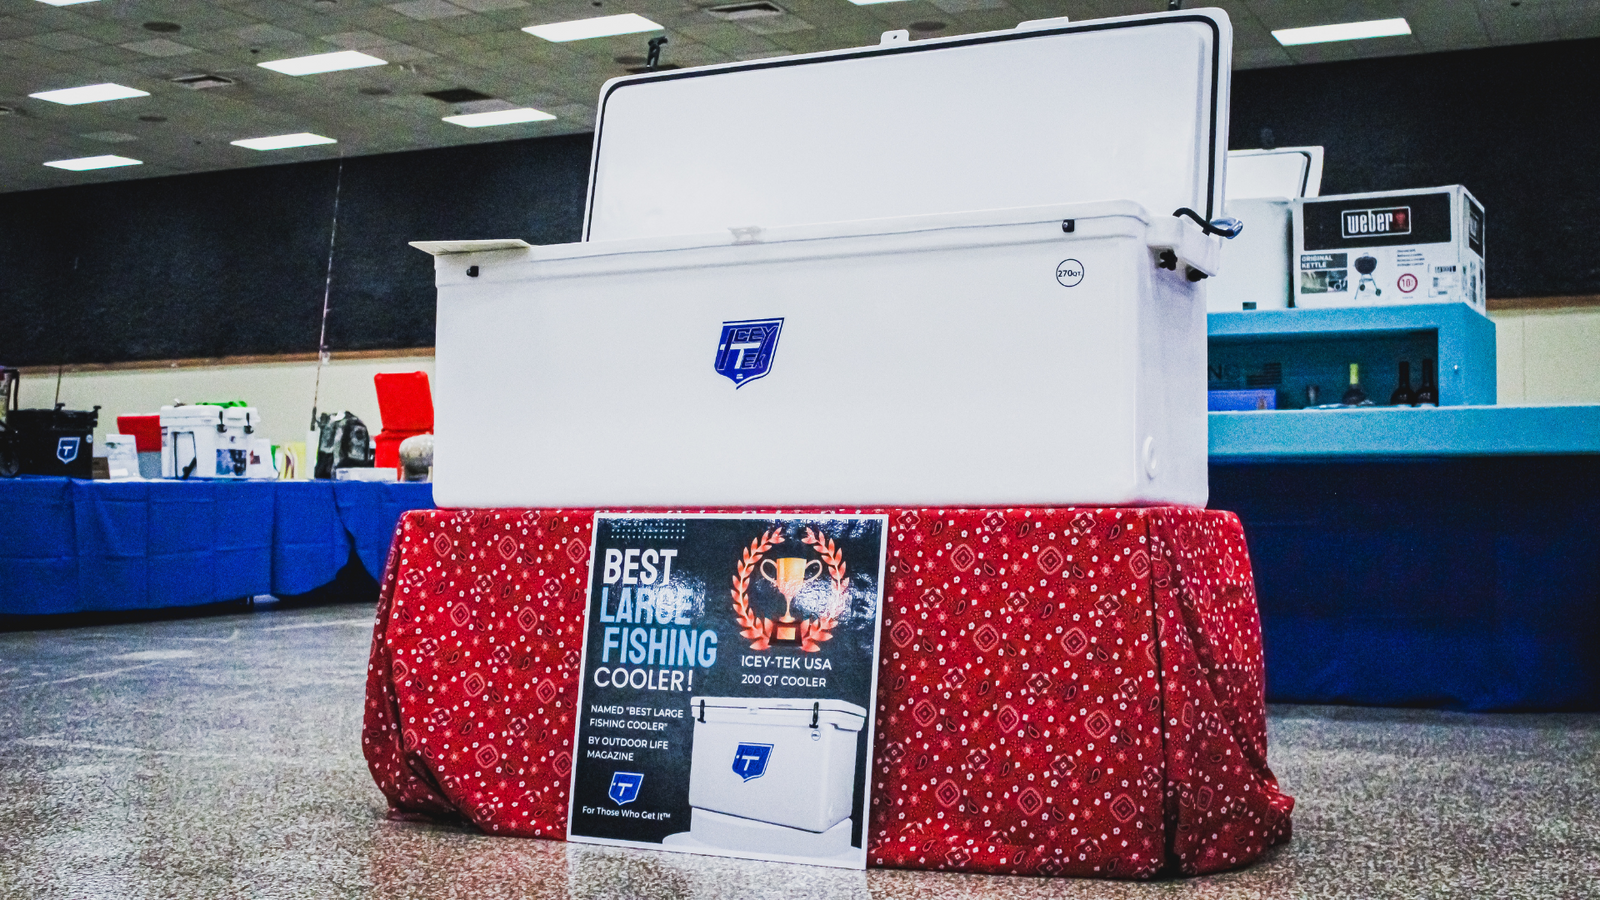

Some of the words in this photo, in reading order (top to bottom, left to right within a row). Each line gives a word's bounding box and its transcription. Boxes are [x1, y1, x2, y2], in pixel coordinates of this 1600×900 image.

[1346, 209, 1393, 234] weber
[1301, 261, 1327, 269] KETTLE
[603, 548, 678, 586] BEST
[600, 586, 694, 626] LARGE
[602, 626, 718, 668] FISHING
[741, 655, 801, 669] ICEY-TEK
[804, 657, 832, 671] USA
[593, 666, 693, 692] COOLER!
[741, 674, 761, 685] 200
[763, 675, 778, 687] QT
[780, 676, 826, 688] COOLER
[590, 705, 624, 715] NAMED
[625, 706, 652, 717] "BEST
[653, 708, 684, 719] LARGE
[589, 718, 625, 729] FISHING
[626, 720, 668, 731] COOLER"
[588, 736, 600, 745] BY
[601, 736, 648, 748] OUTDOOR
[649, 740, 669, 750] LIFE
[586, 749, 634, 762] MAGAZINE
[582, 805, 595, 815] For
[596, 806, 620, 817] Those
[621, 809, 640, 819] Who
[641, 811, 656, 820] Get
